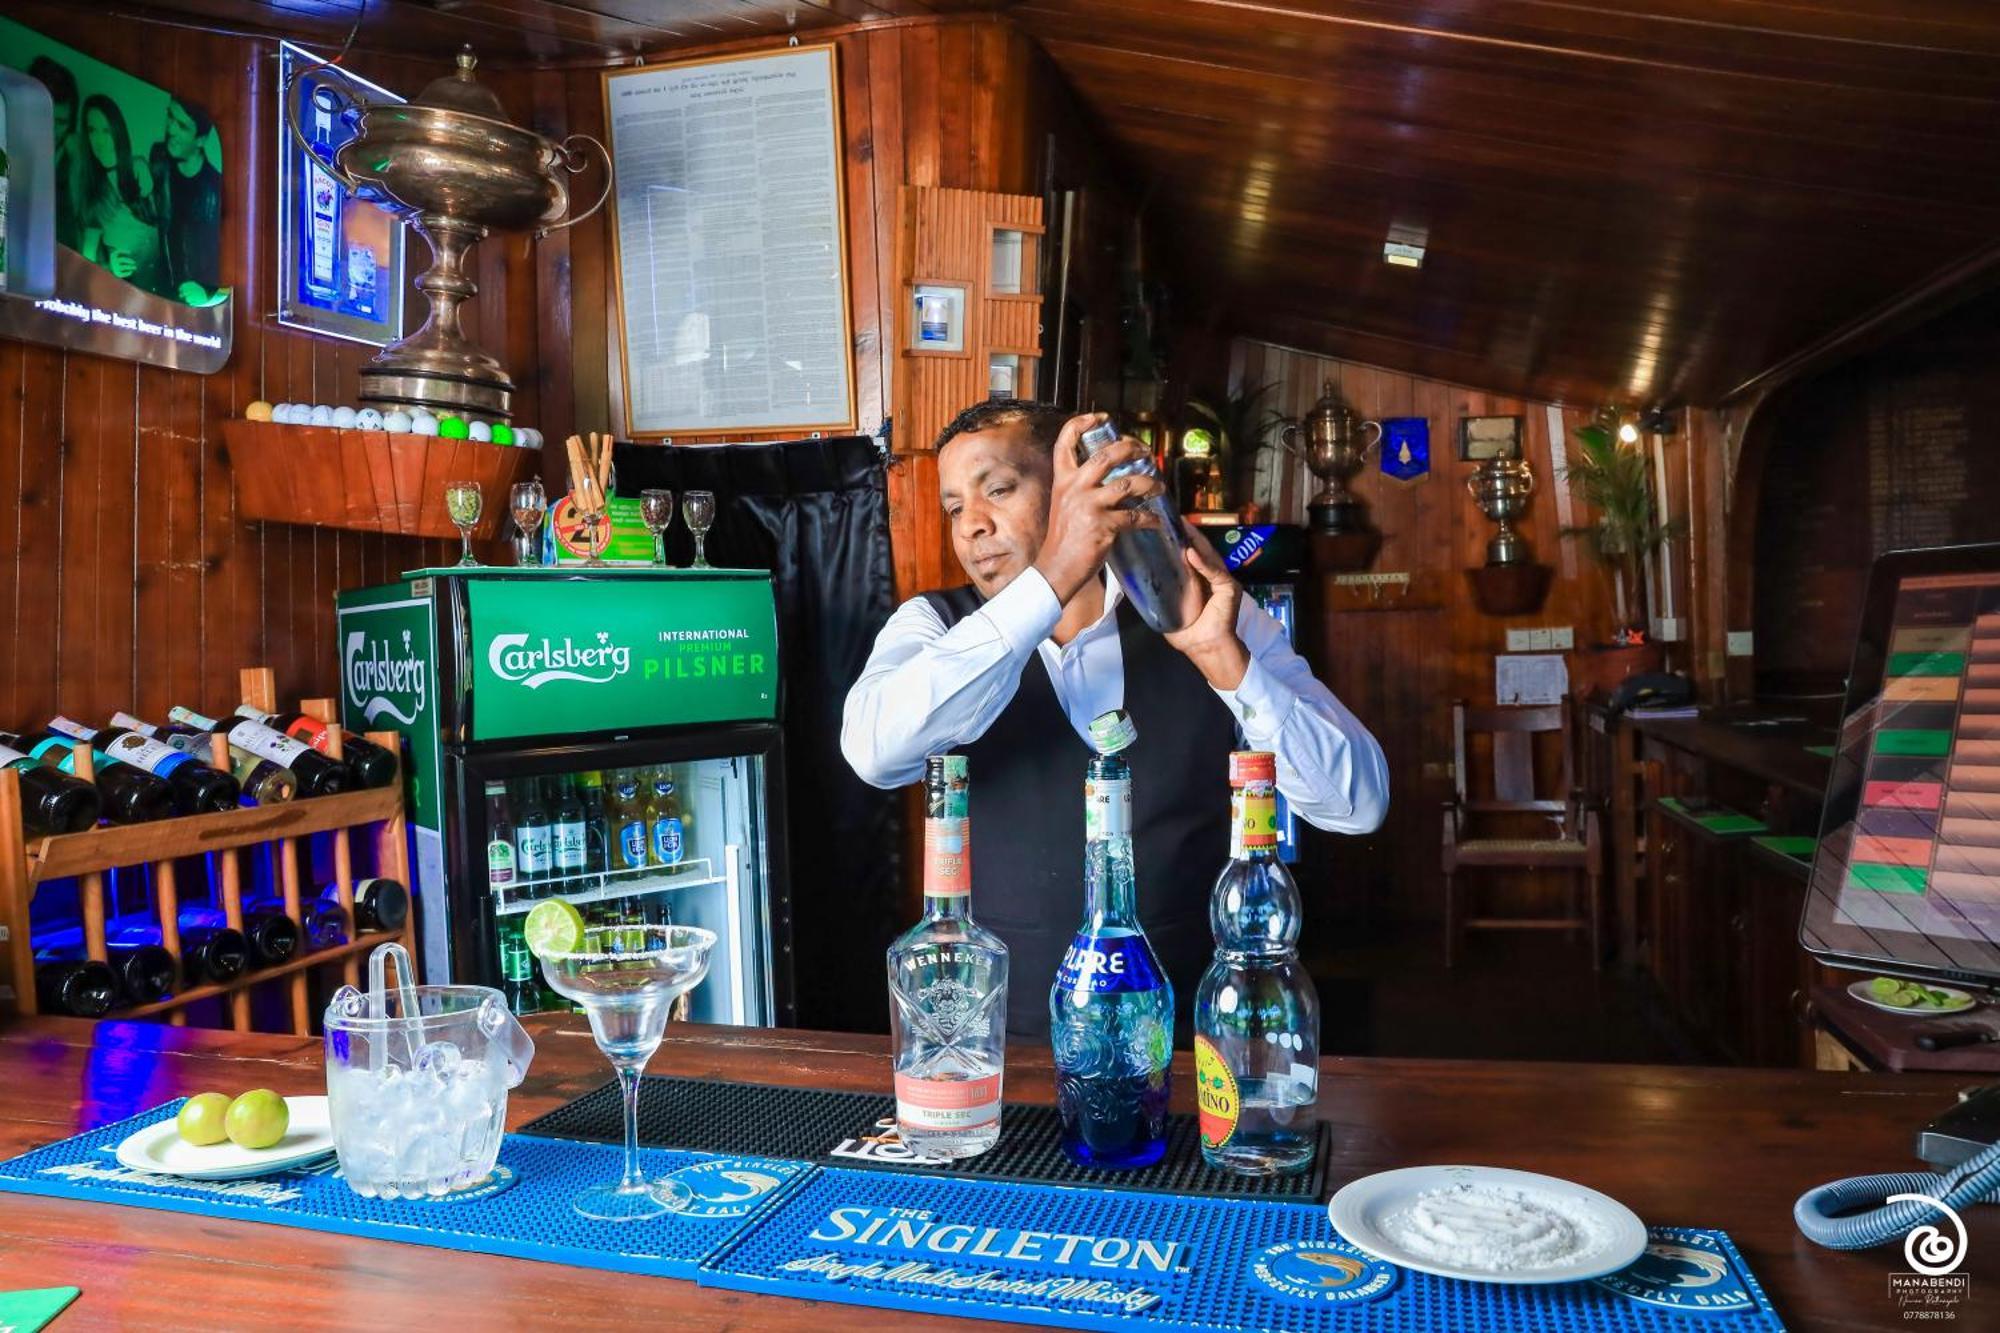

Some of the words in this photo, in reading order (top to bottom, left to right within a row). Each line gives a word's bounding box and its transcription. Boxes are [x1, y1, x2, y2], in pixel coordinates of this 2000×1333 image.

[91, 309, 112, 324] the
[112, 312, 138, 331] best
[138, 318, 164, 336] beer
[163, 324, 175, 339] in
[175, 328, 193, 343] the
[193, 333, 222, 350] world
[1229, 531, 1265, 565] SODA
[659, 629, 749, 641] INTERNATIONAL
[679, 641, 732, 653] PREMIUM
[488, 633, 630, 680] Carlsberg
[643, 654, 764, 680] PILSNER
[346, 631, 425, 714] Carlsberg
[939, 866, 958, 876] SEC
[922, 1110, 952, 1120] TRIPLE
[953, 1110, 972, 1119] SEC
[889, 1207, 933, 1220] THE
[809, 1207, 1180, 1272] SINGLETON
[1265, 1242, 1294, 1255] THE
[783, 1252, 886, 1280] Single
[884, 1261, 961, 1287] Malt
[946, 1270, 1053, 1296] Scotch
[1048, 1277, 1161, 1311] Whisky
